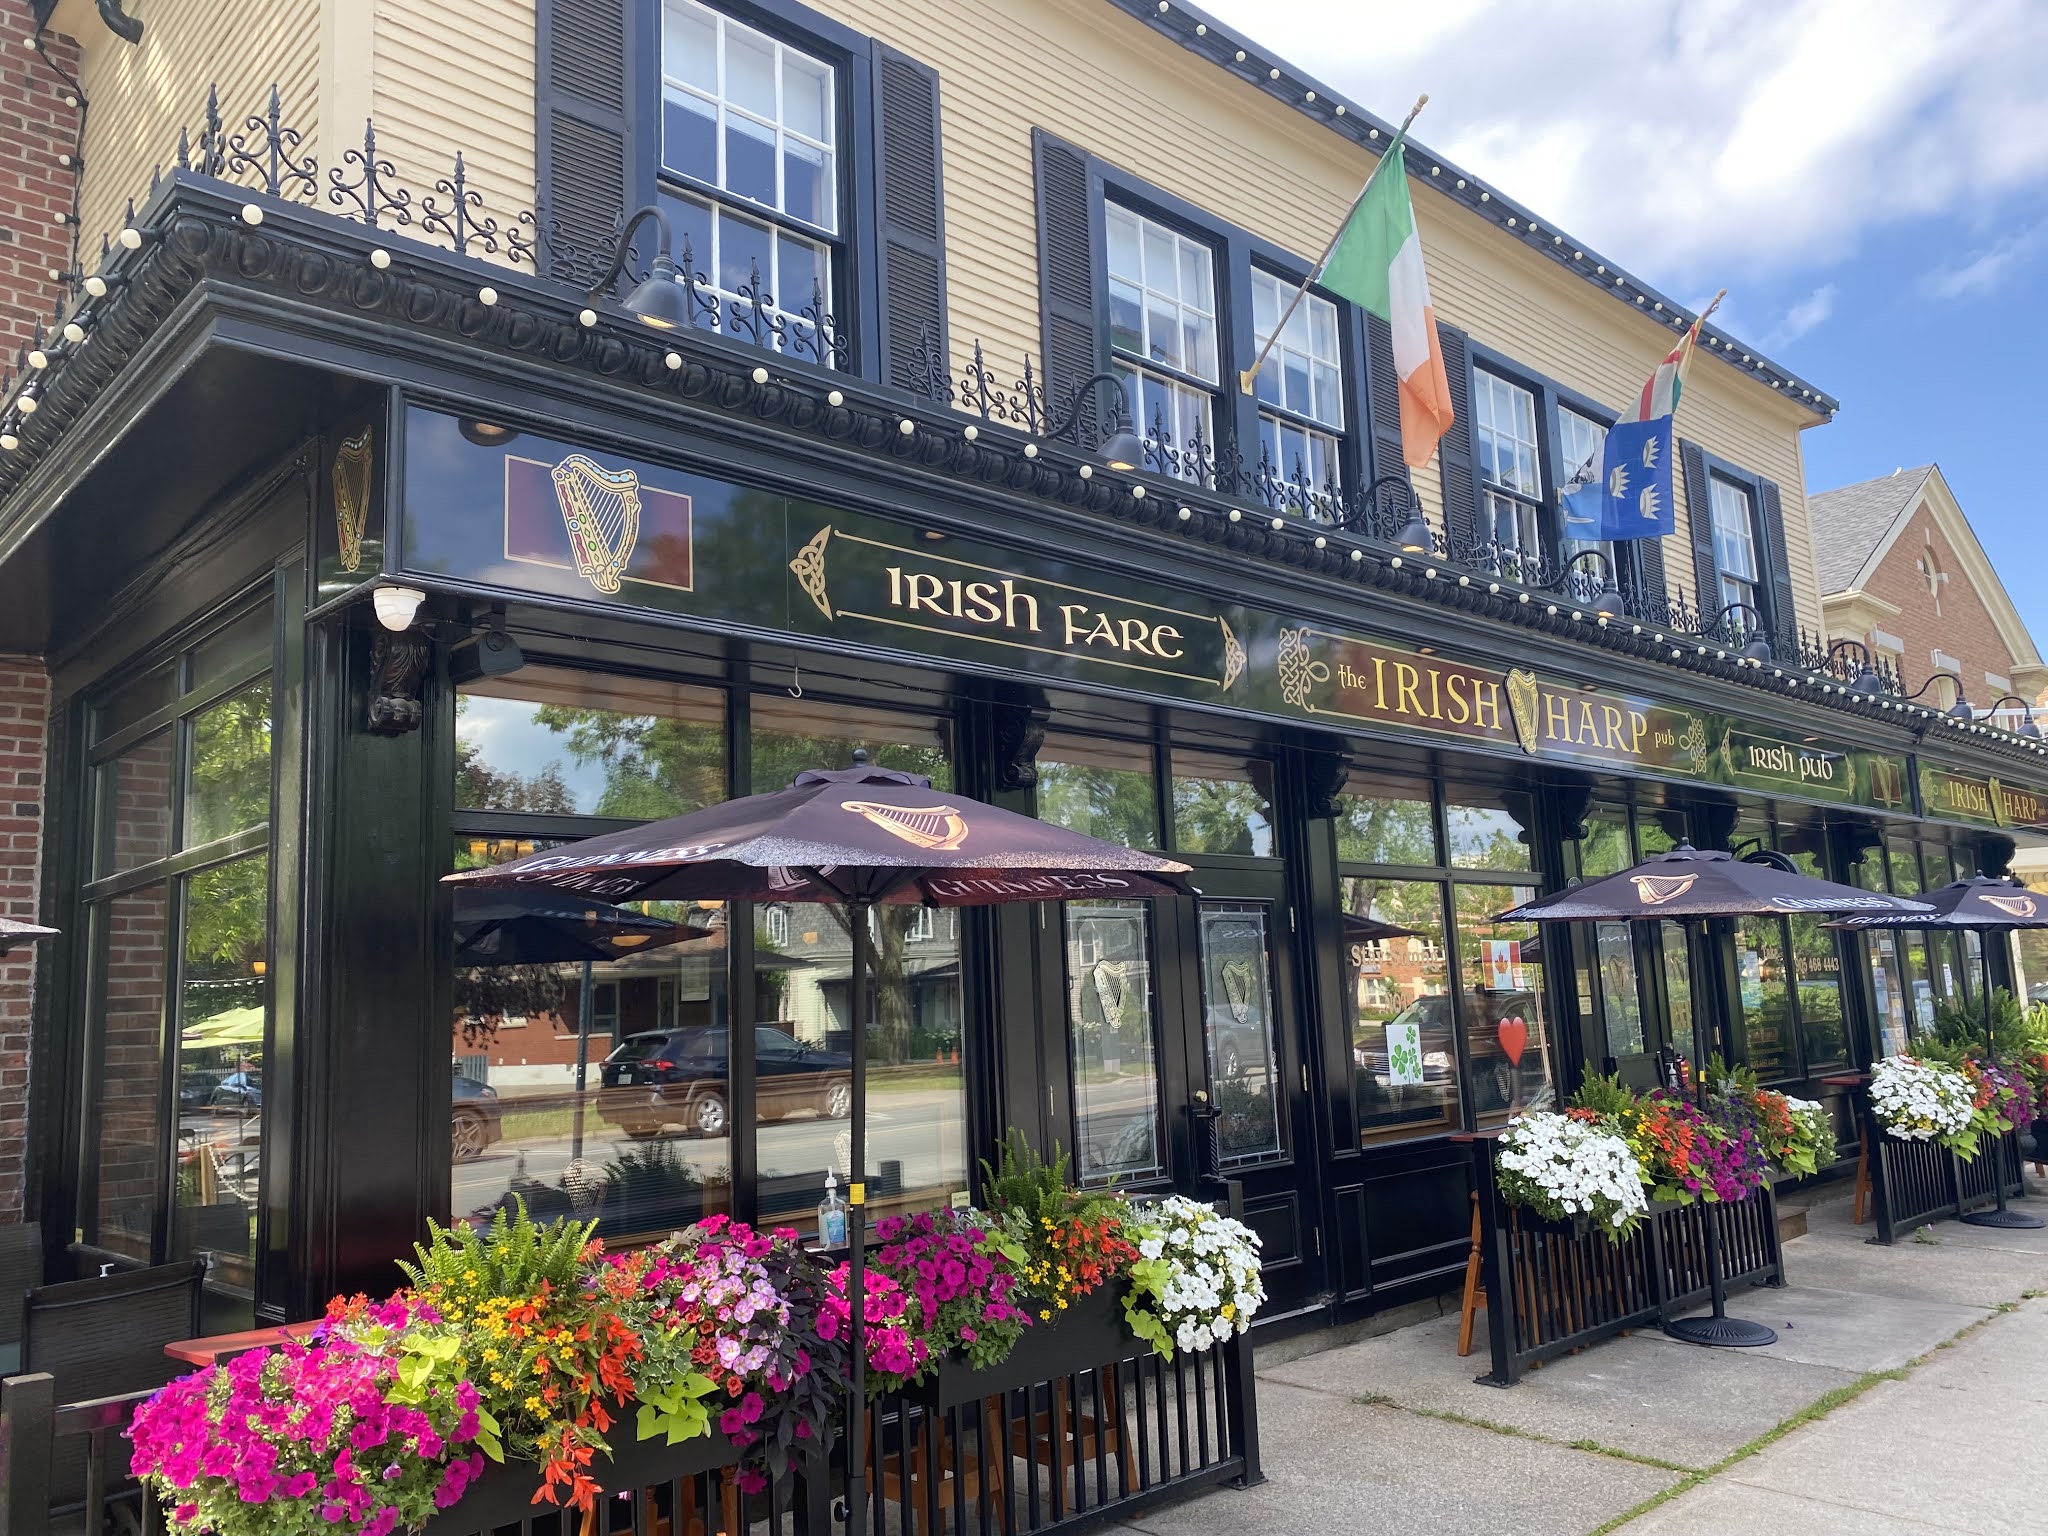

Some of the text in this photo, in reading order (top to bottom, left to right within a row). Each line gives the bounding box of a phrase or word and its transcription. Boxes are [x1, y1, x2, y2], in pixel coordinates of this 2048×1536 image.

[1337, 656, 1675, 754] the IRISH HARP pub
[1798, 753, 1833, 781] pub
[1948, 780, 1989, 812] IRISH
[2002, 792, 2038, 820] HARP
[928, 872, 1130, 897] GUINNESS
[1771, 897, 1894, 909] GUINNESS
[1796, 956, 1840, 973] 905 468 4443
